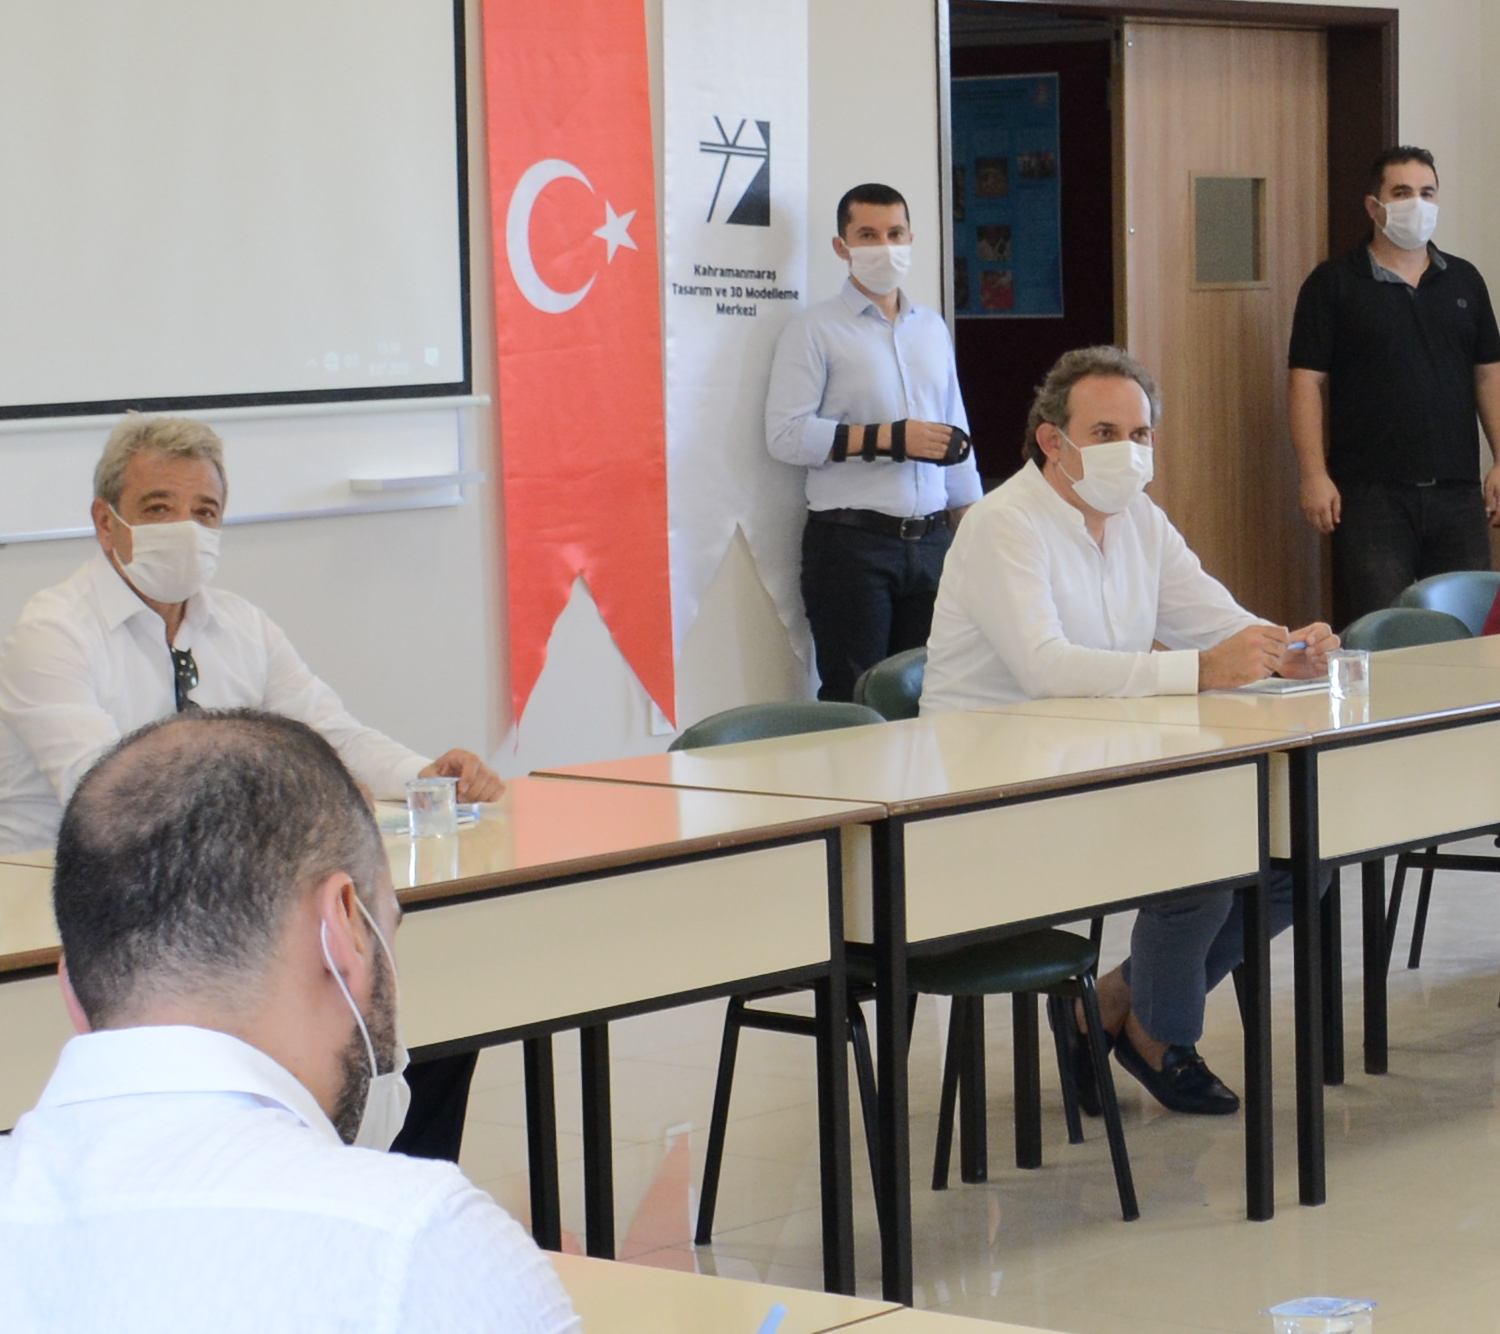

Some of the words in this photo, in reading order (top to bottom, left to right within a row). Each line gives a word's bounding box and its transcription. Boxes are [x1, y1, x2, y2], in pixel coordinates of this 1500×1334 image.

[693, 264, 777, 281] Kahramanmaraş
[672, 283, 712, 297] Tasarım
[715, 286, 727, 297] ve
[730, 286, 743, 298] 3D
[745, 287, 799, 300] Modelleme
[716, 302, 757, 316] Merkezi
